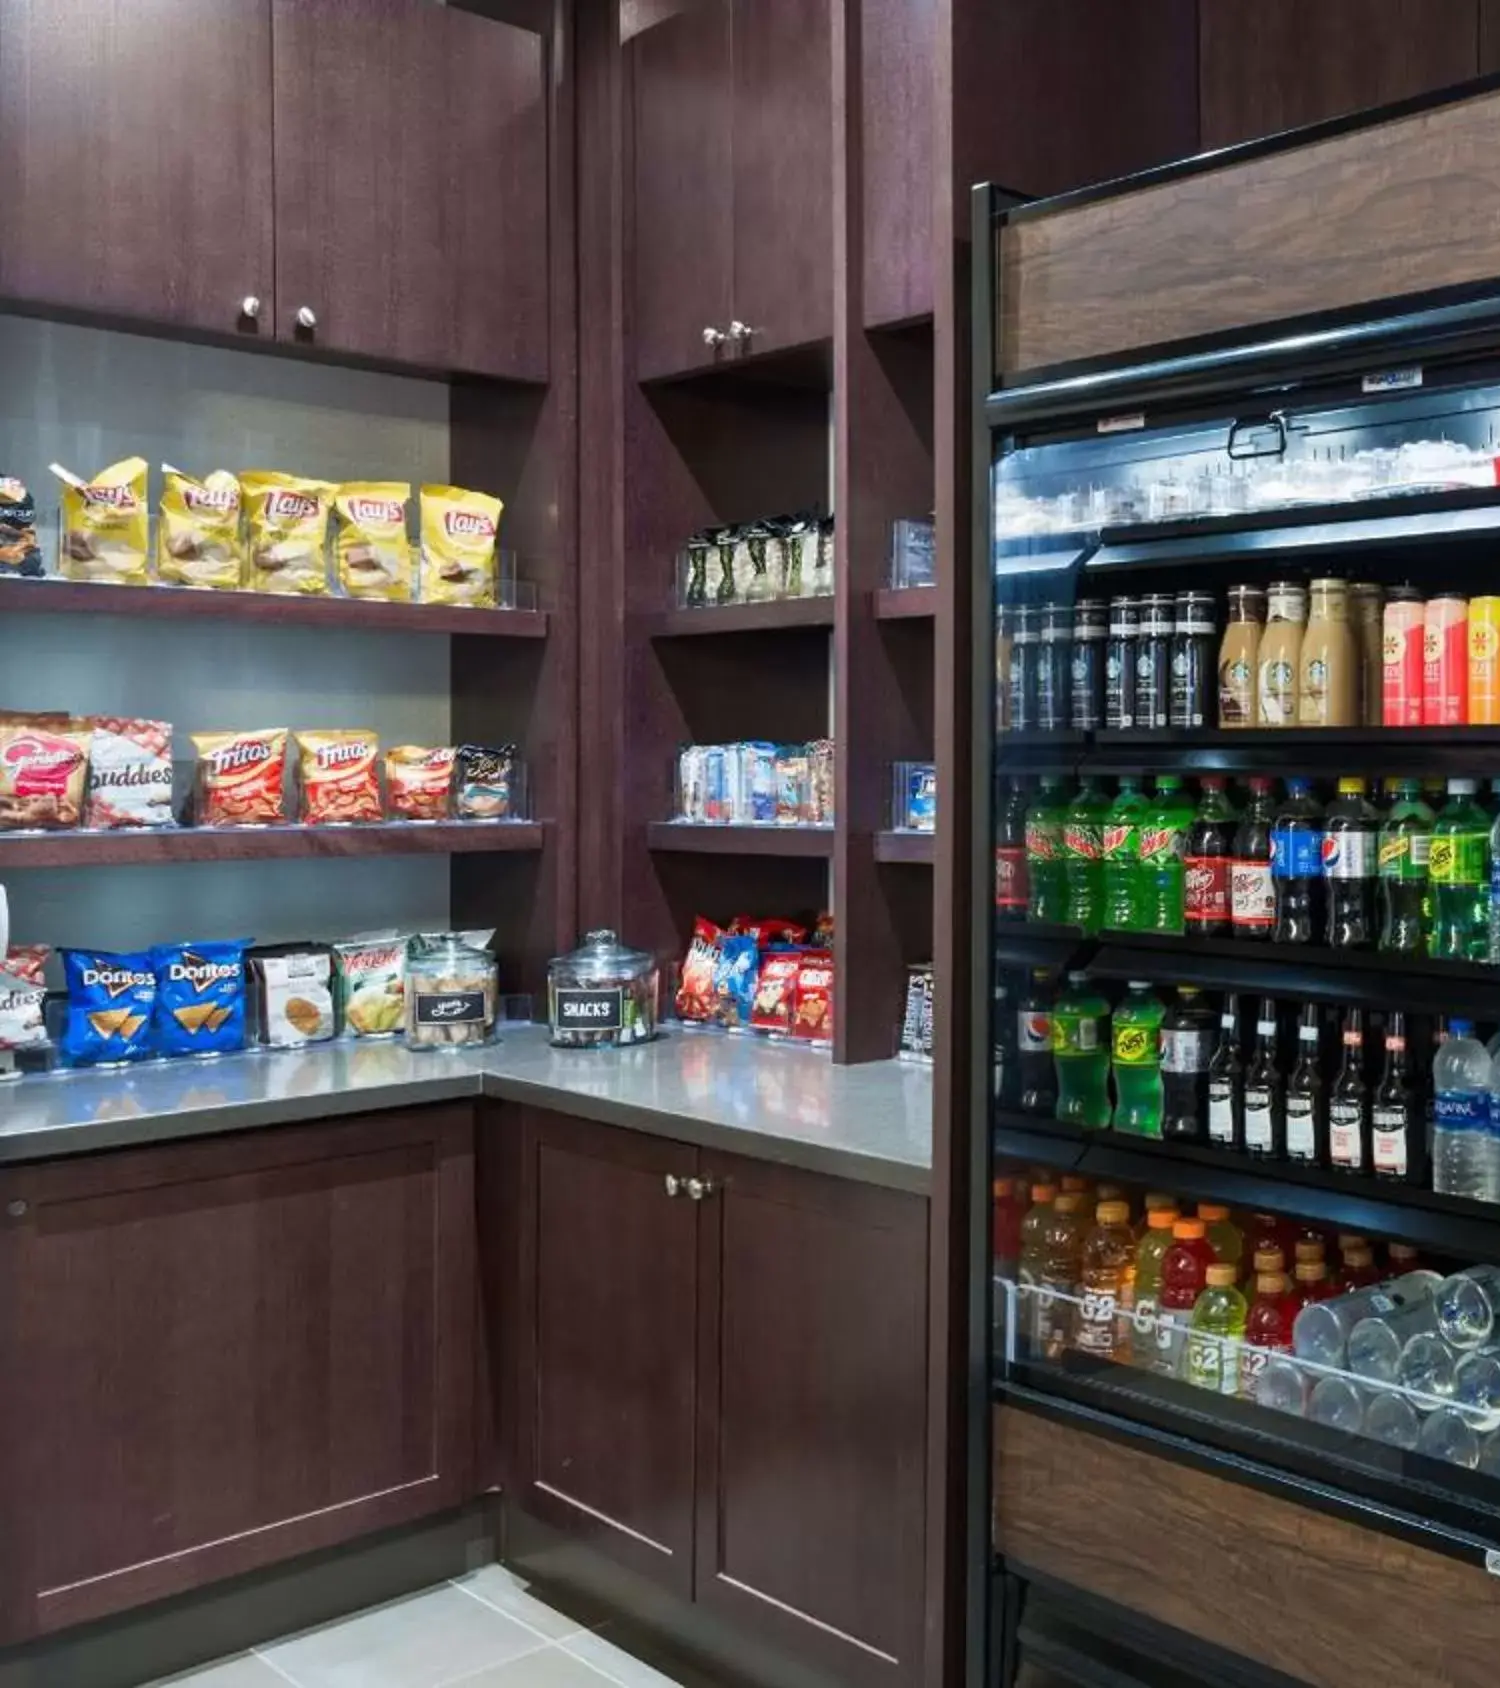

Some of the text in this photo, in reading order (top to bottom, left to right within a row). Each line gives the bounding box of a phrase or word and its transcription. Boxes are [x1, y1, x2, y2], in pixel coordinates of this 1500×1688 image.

[83, 969, 156, 986] Doritos
[170, 962, 241, 981] Doritos
[563, 1002, 611, 1017] SNACKS
